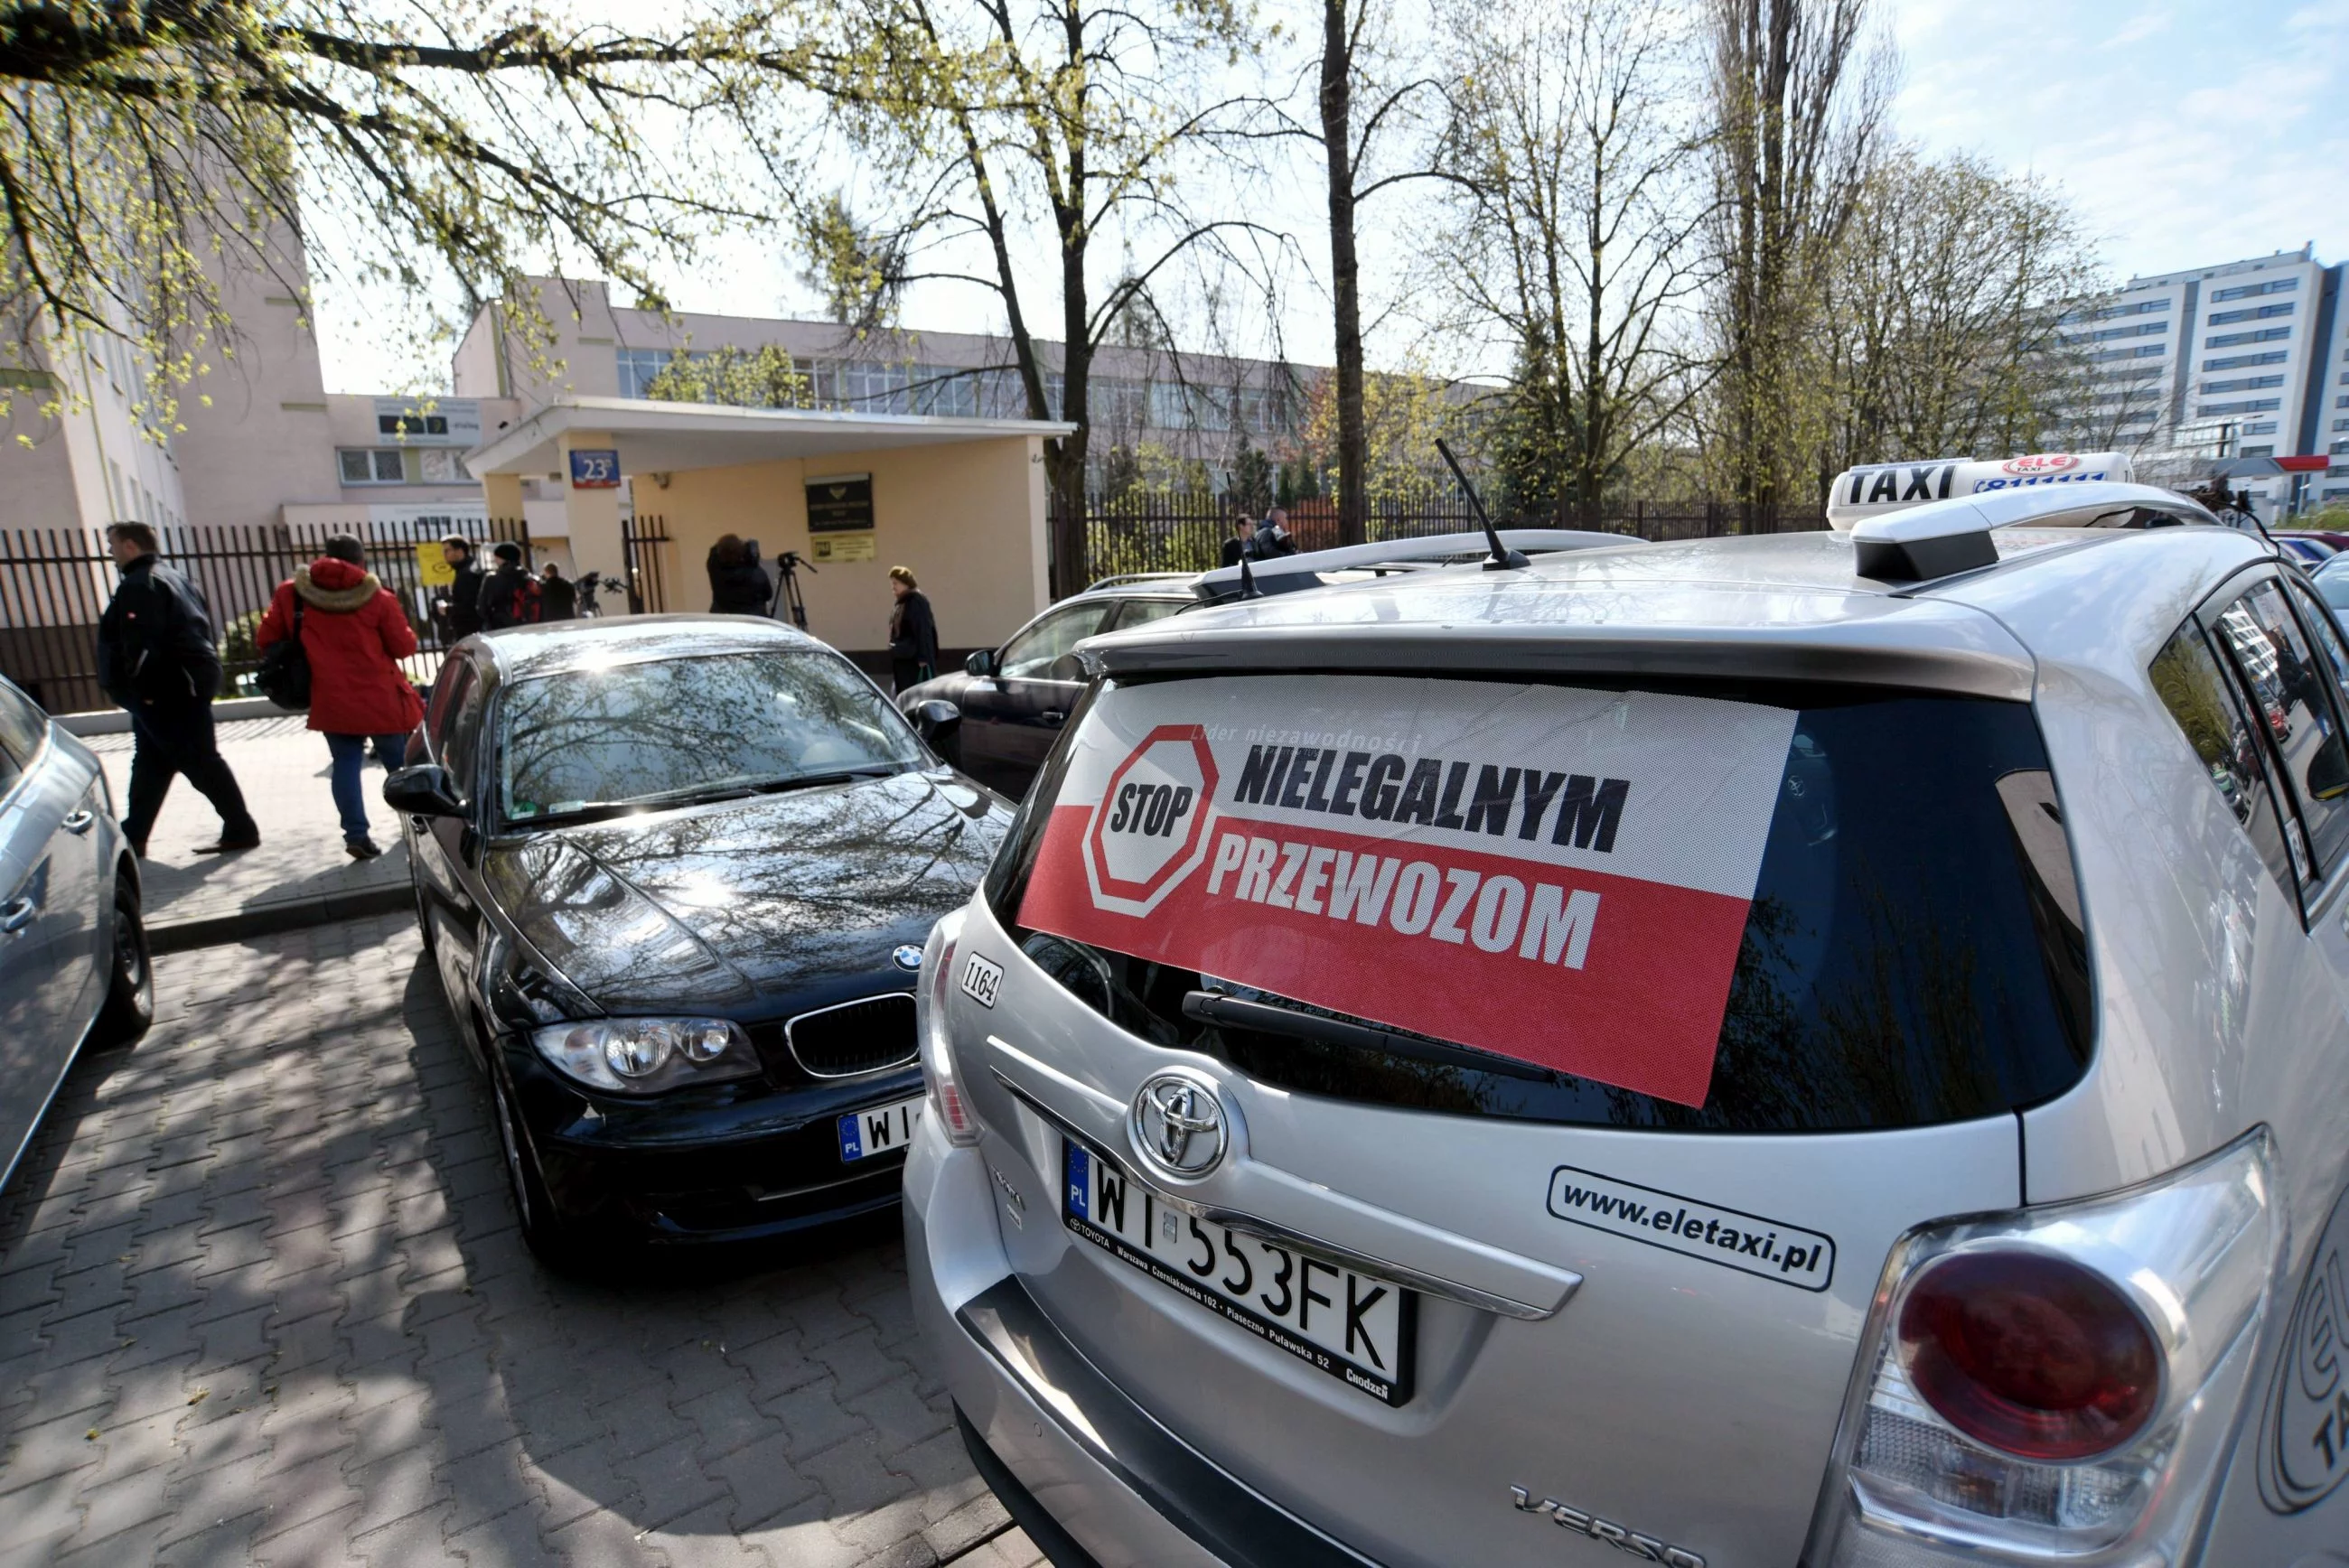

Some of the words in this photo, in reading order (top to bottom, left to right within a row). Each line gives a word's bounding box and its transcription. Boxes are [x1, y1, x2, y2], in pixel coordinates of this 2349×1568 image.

[583, 458, 608, 480] 23
[1849, 463, 1957, 504] TAXI
[2017, 454, 2068, 468] ELE
[1190, 723, 1237, 742] Lider
[1109, 781, 1193, 839] STOP
[1233, 744, 1631, 854] NIELEGALNYM
[1206, 833, 1601, 971] PRZEWOZOM
[963, 961, 998, 1002] 1164
[845, 1142, 859, 1153] PL
[1071, 1184, 1086, 1208] PL
[1563, 1184, 1823, 1273] www.eletaxi.pl
[1097, 1160, 1153, 1250] WI
[1186, 1217, 1389, 1371] 553FK
[1081, 1224, 1110, 1249] TOYOTA
[1117, 1246, 1148, 1270] Warszawa
[1152, 1265, 1203, 1301] Czerniakowska
[1203, 1294, 1218, 1310] 102
[1226, 1306, 1265, 1335] Piaseczno
[1268, 1329, 1313, 1360] Puławska
[1317, 1354, 1331, 1369] 52
[1509, 1482, 1708, 1568] VERSO
